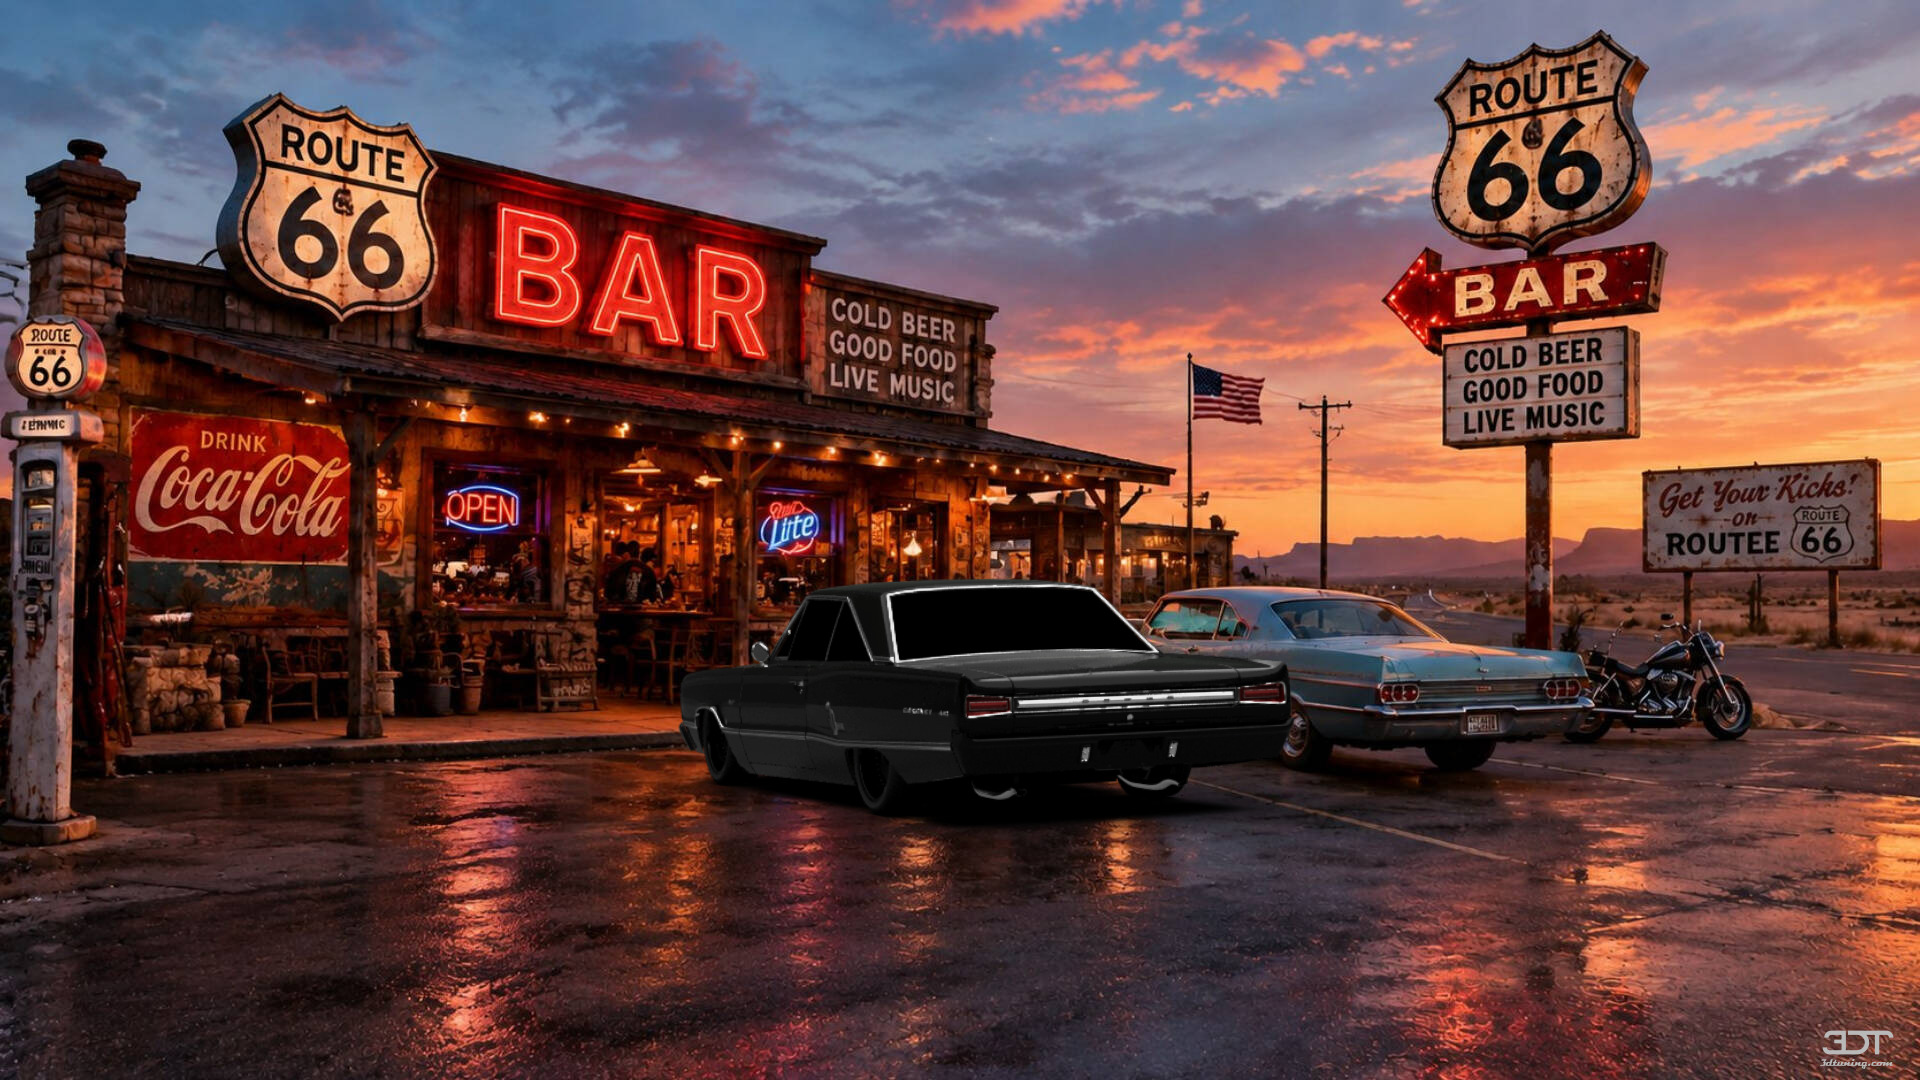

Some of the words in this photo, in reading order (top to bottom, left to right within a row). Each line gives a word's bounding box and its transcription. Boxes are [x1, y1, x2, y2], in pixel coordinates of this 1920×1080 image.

[1469, 59, 1599, 117] ROUTE
[281, 123, 405, 184] ROUTE
[1466, 116, 1603, 222] 66
[277, 185, 404, 290] 66
[494, 201, 769, 361] BAR
[1454, 259, 1609, 318] BAR
[31, 328, 72, 342] ROUTE
[831, 297, 892, 330] COLD
[902, 311, 956, 343] BEER
[29, 355, 71, 387] 66
[829, 330, 893, 362] GOOD
[901, 343, 957, 373] FOOD
[1463, 345, 1527, 374] COLD
[1538, 337, 1603, 367] BEER
[830, 362, 879, 393] LIVE
[890, 373, 955, 403] MUSIC
[1463, 376, 1527, 404] GOOD
[1538, 370, 1604, 399] FOOD
[1463, 408, 1515, 435] LIVE
[1526, 401, 1605, 430] MUSIC
[200, 430, 267, 452] DRINK
[135, 445, 352, 537] Coca-Cola
[447, 493, 515, 524] OPEN
[1658, 483, 1704, 518] Get
[1714, 479, 1770, 513] Your
[1775, 471, 1858, 503] Kicks!
[1802, 511, 1840, 521] ROUTE
[1666, 531, 1781, 556] ROUTEE
[1801, 526, 1842, 553] 66
